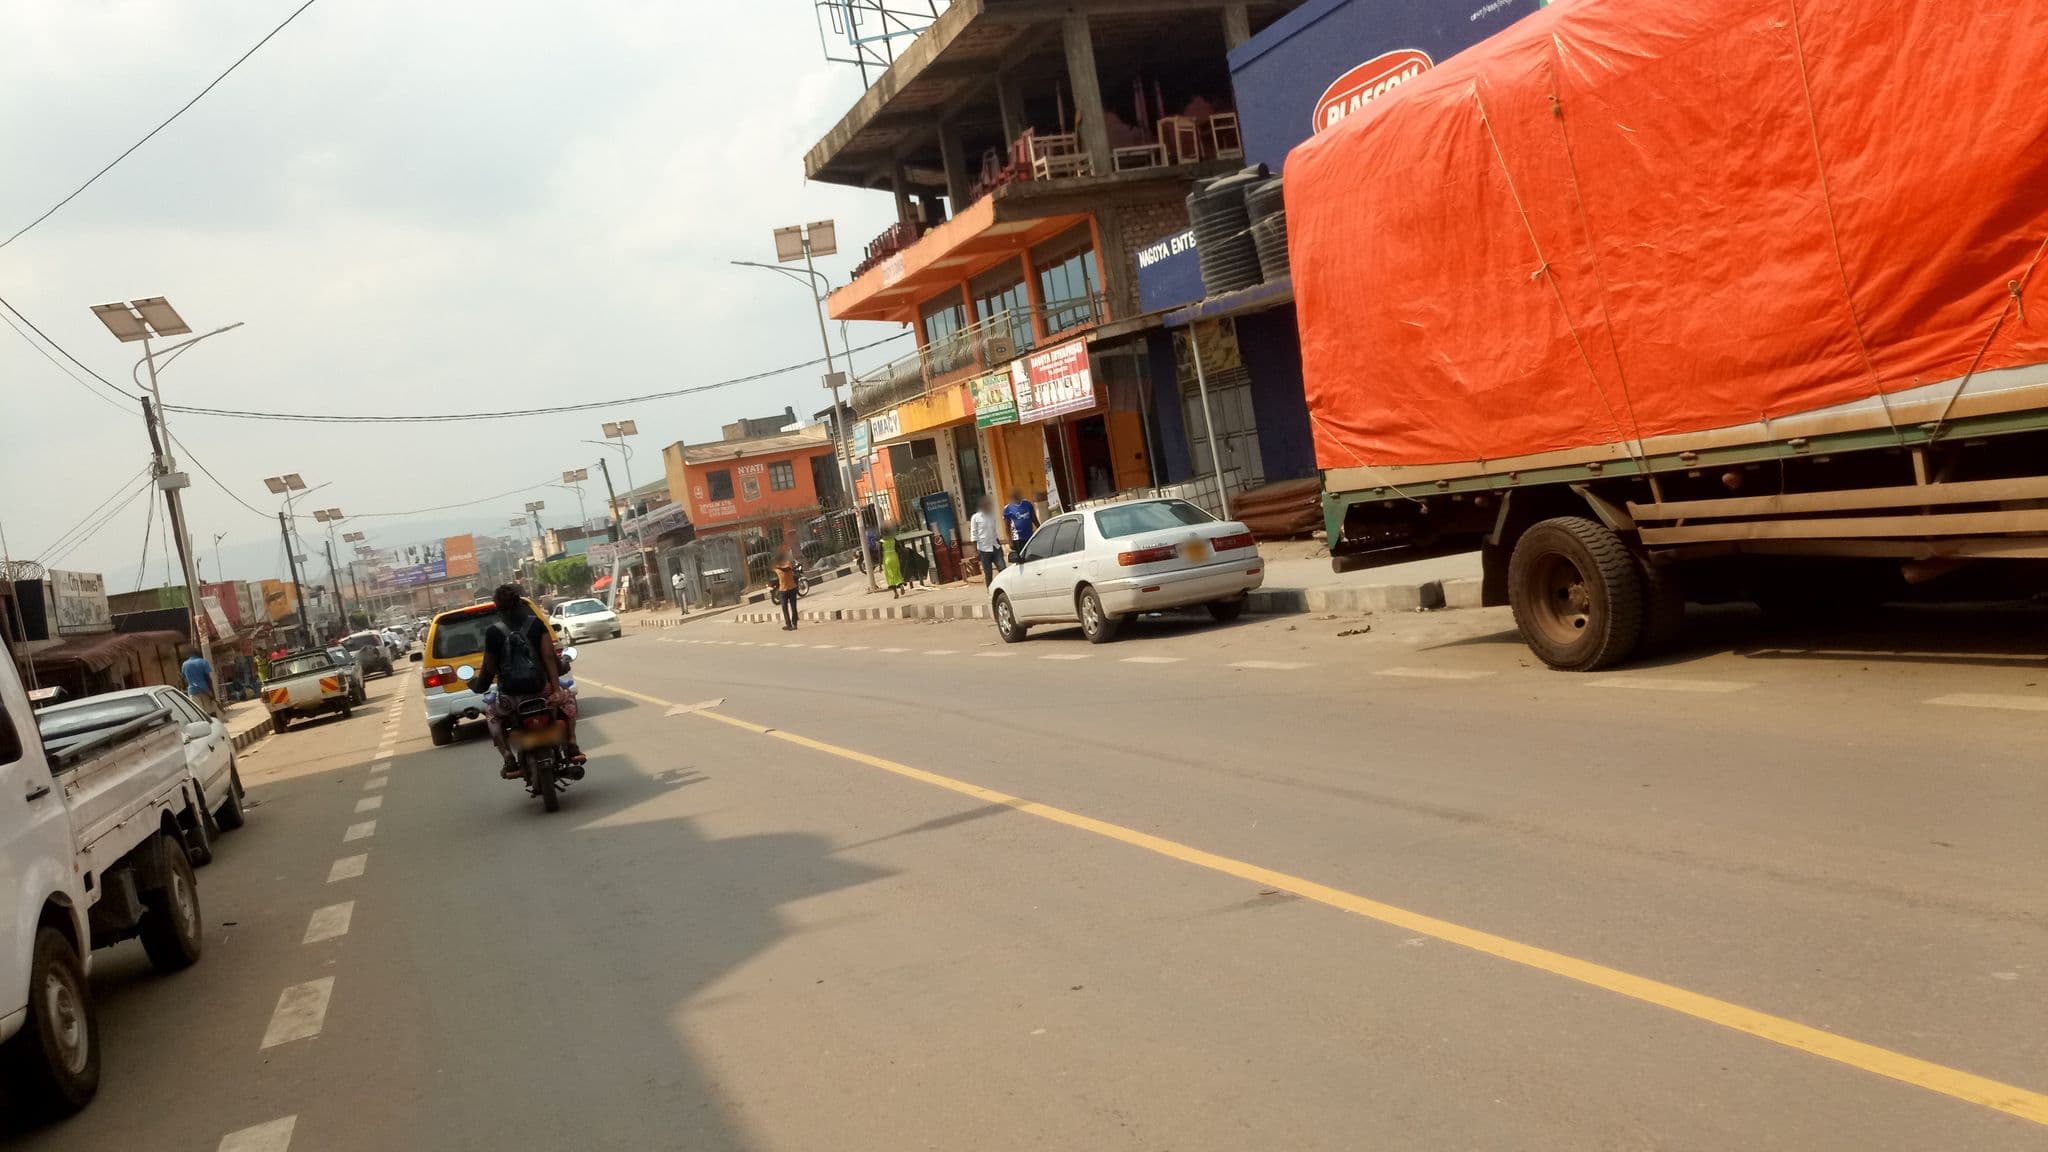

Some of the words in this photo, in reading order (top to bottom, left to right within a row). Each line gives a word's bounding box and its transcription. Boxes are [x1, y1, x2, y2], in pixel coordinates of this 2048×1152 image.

[1138, 241, 1170, 268] NAGOYA
[736, 463, 764, 475] NYATI
[943, 429, 963, 518] PHARMACY
[978, 431, 994, 495] HARMA
